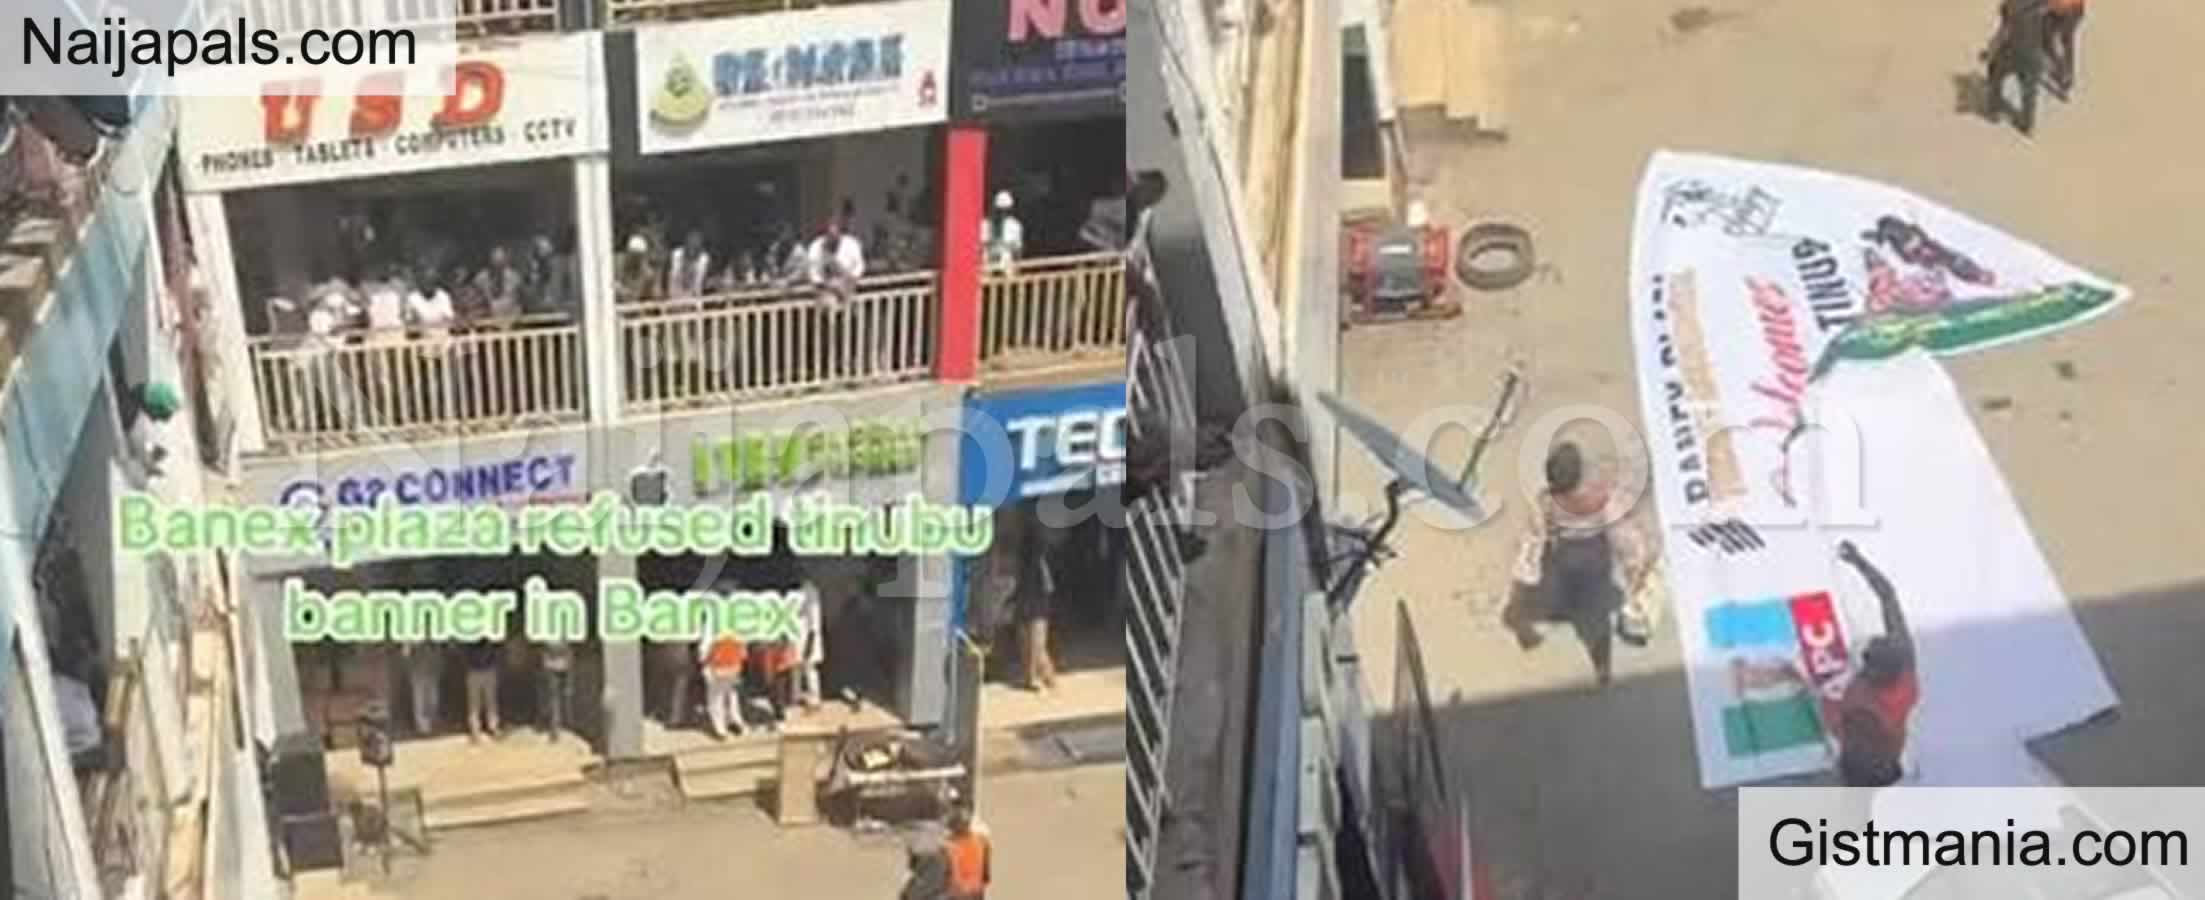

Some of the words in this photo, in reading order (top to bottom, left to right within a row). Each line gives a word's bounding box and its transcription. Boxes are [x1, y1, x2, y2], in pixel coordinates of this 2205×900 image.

[260, 61, 506, 143] USD
[202, 147, 274, 176] PHONES
[295, 135, 375, 163] TABLETS
[395, 123, 505, 156] COMPUTERS
[524, 117, 577, 143] CCTV
[396, 455, 573, 503] CONNECT
[1802, 620, 1850, 701] APC
